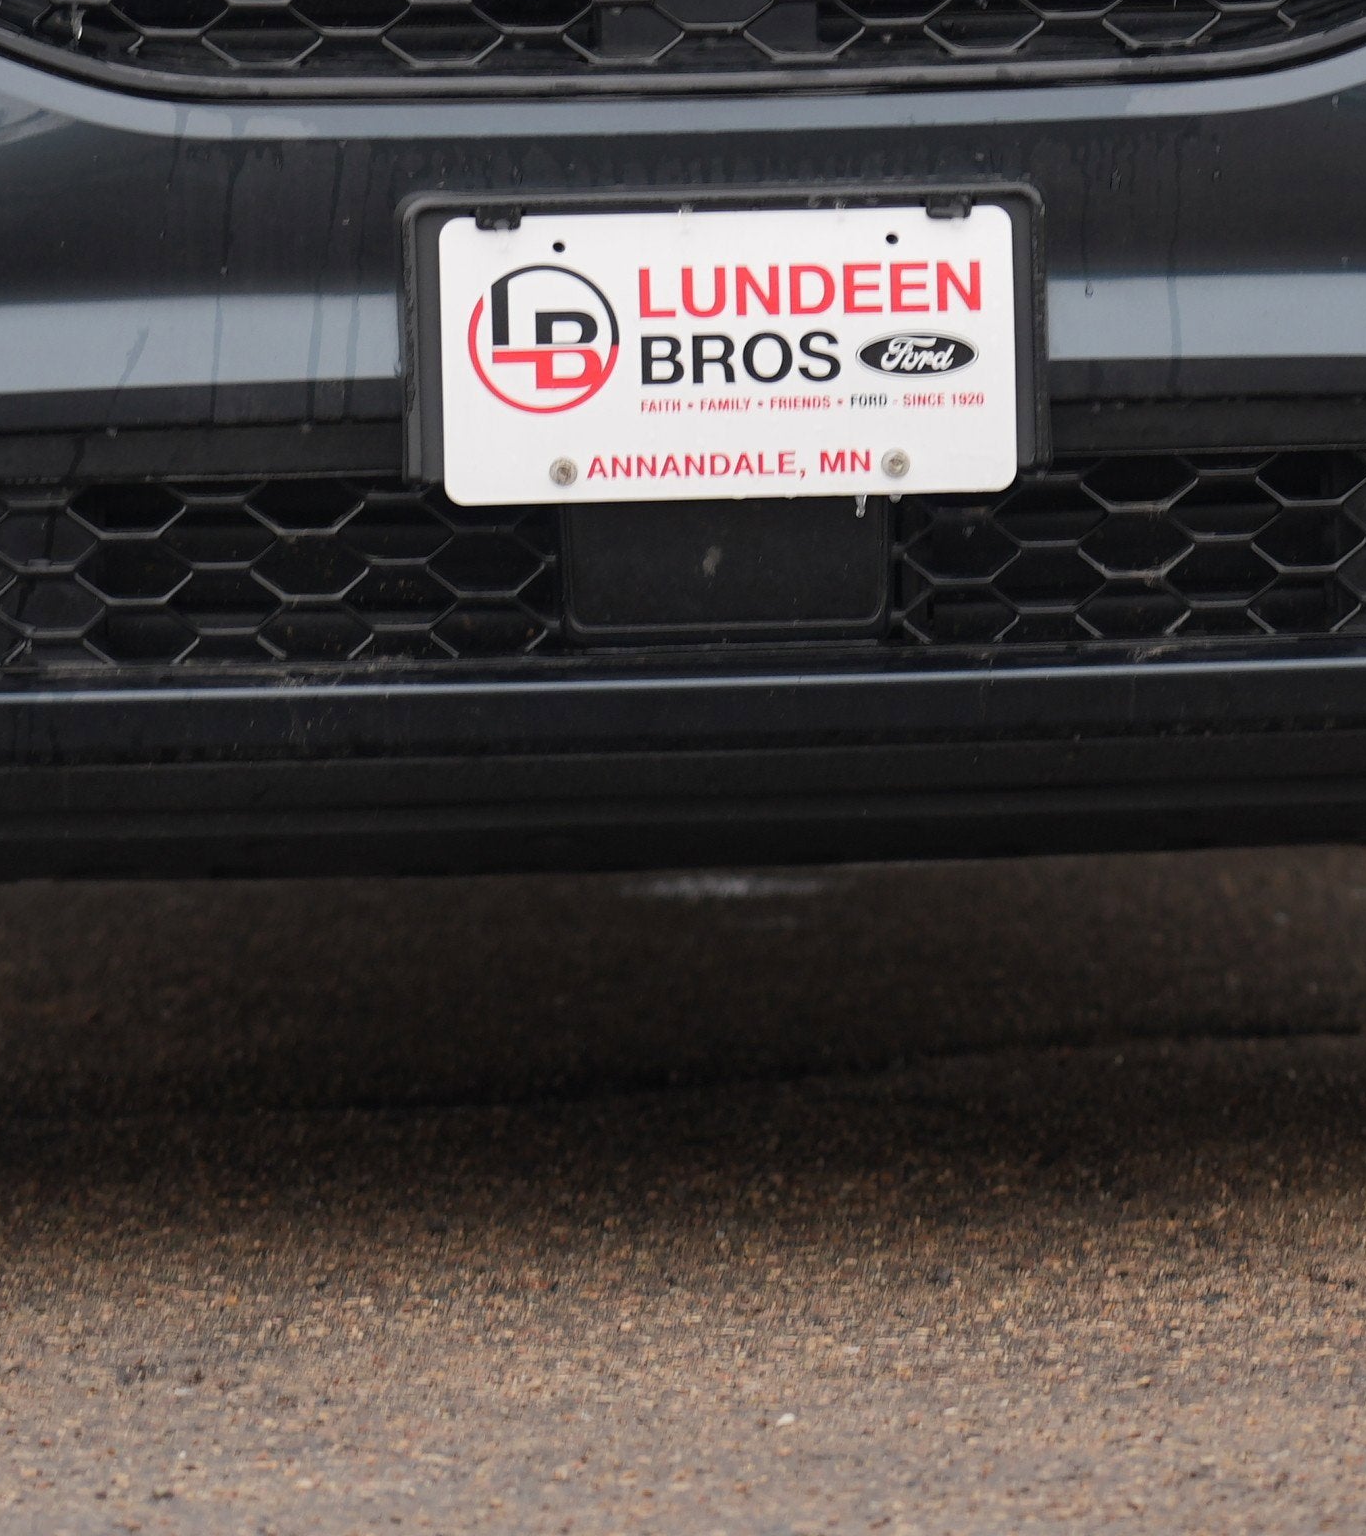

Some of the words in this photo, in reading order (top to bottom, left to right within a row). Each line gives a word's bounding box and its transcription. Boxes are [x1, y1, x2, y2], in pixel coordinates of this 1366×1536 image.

[638, 260, 981, 319] LUNDEEN
[641, 331, 841, 386] BROS
[880, 337, 955, 372] Ford
[640, 398, 682, 413] FAITH
[700, 396, 751, 412] FAMILY
[770, 395, 831, 410] FRIENDS
[850, 393, 888, 408] FORD
[902, 392, 945, 407] SINCE
[586, 450, 806, 480] ANNANDALE,
[819, 449, 872, 473] MN
